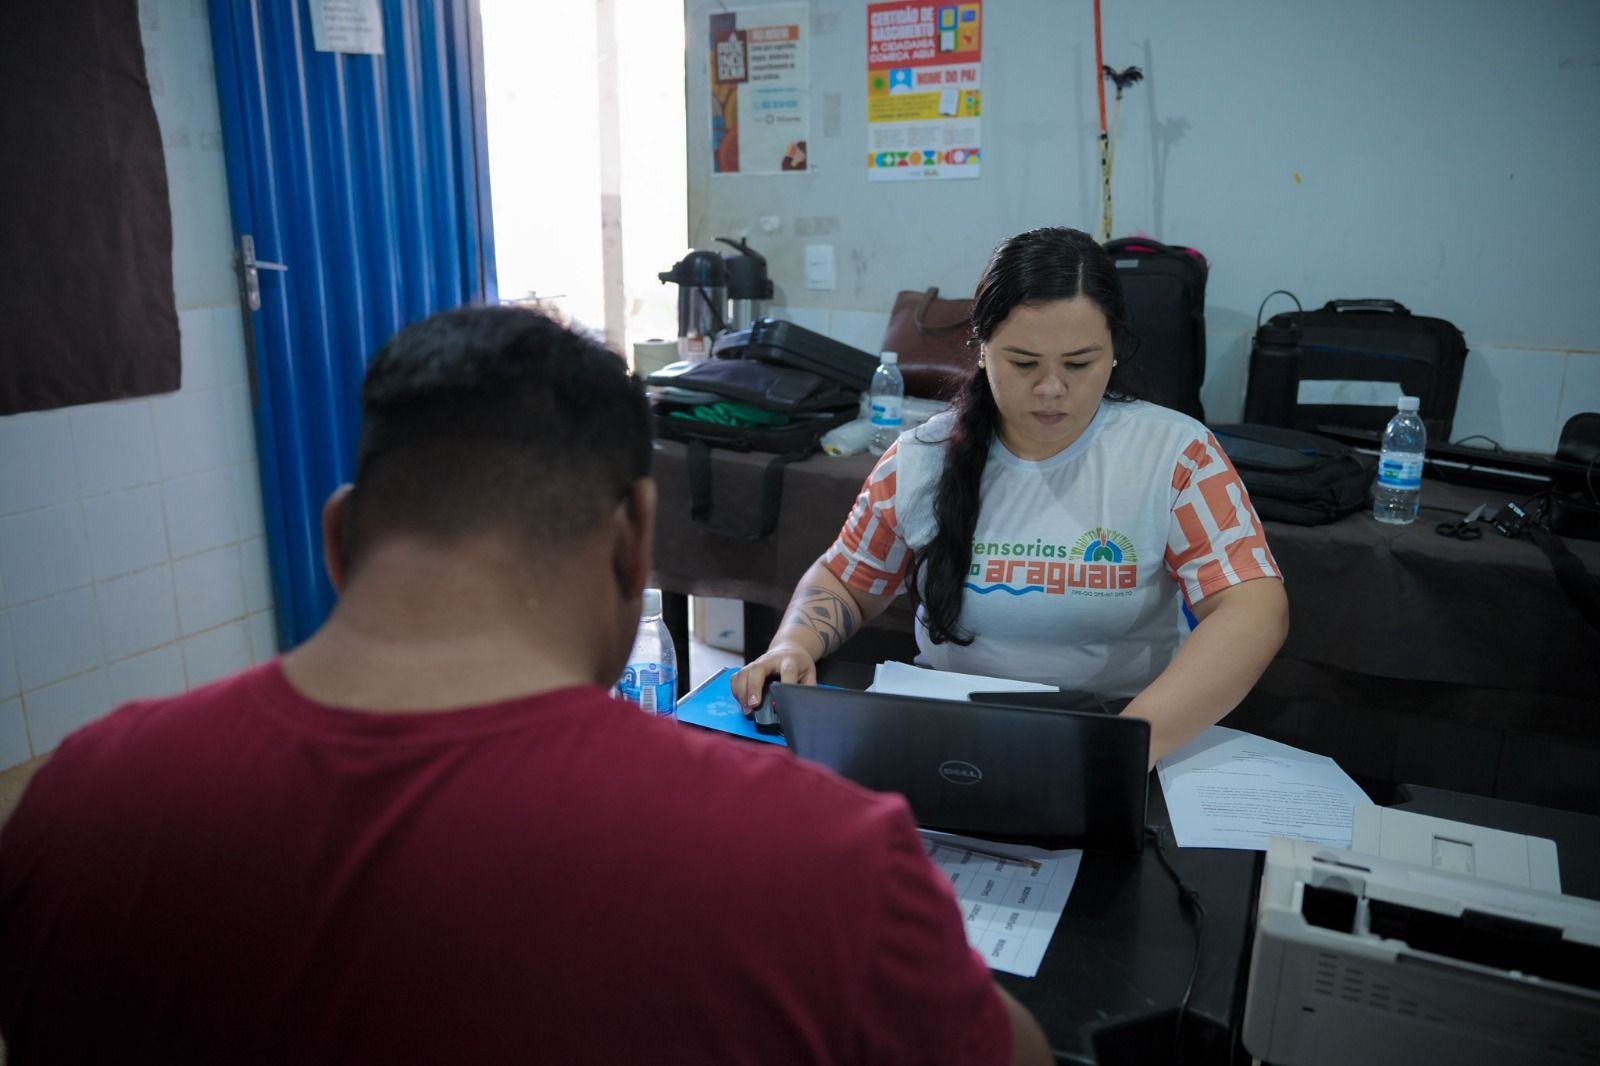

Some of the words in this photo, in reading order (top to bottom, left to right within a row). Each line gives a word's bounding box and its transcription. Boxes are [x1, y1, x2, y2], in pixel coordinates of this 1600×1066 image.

[871, 5, 919, 27] CERTIDÃO
[920, 6, 935, 22] DE
[871, 22, 935, 42] NASCIMENTO
[880, 39, 935, 52] CIDADANIA
[869, 51, 909, 63] COMEÇA
[917, 71, 941, 86] NOME
[945, 70, 958, 83] DO
[961, 68, 976, 82] PAI
[971, 537, 1067, 558] ensorias
[985, 559, 1137, 595] araguaia
[943, 767, 977, 778] DELL
